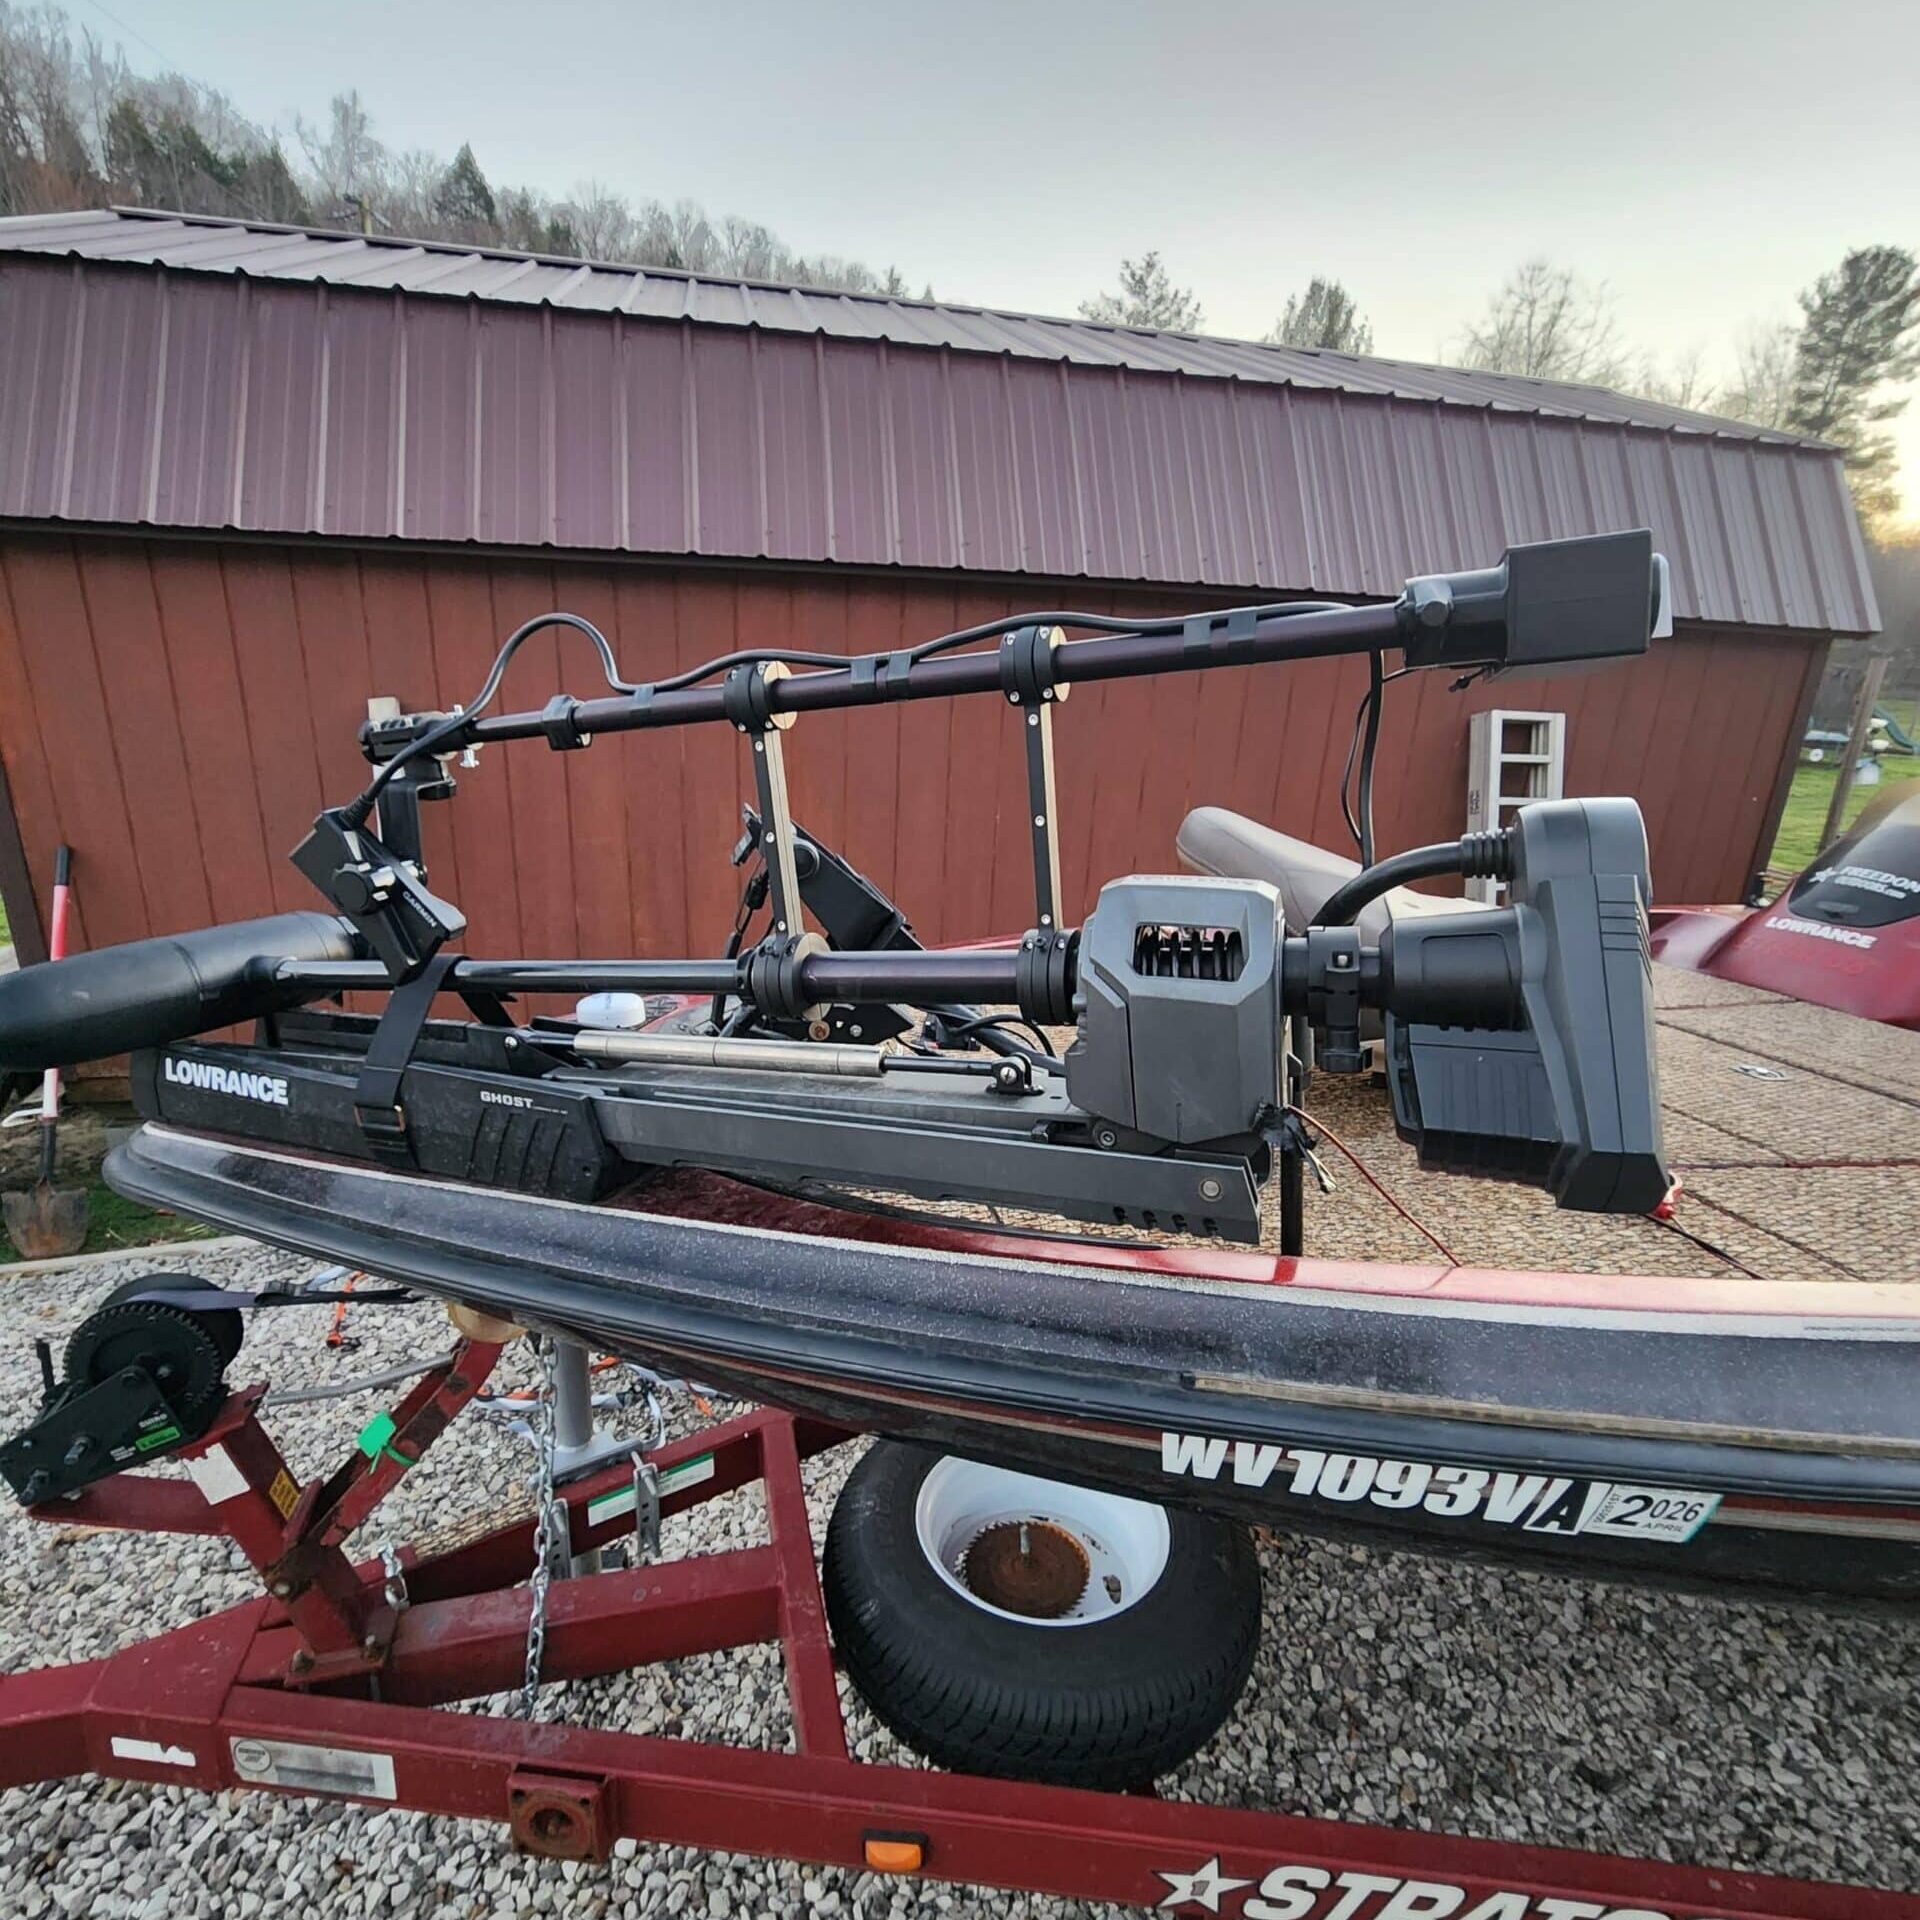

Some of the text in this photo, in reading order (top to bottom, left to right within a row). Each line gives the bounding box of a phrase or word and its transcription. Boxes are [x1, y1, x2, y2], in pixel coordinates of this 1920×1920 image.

[402, 891, 438, 927] GARMIN
[1764, 916, 1878, 949] LOWRANCE
[165, 1057, 288, 1106] LOWRANCE
[480, 1091, 533, 1109] GHOST
